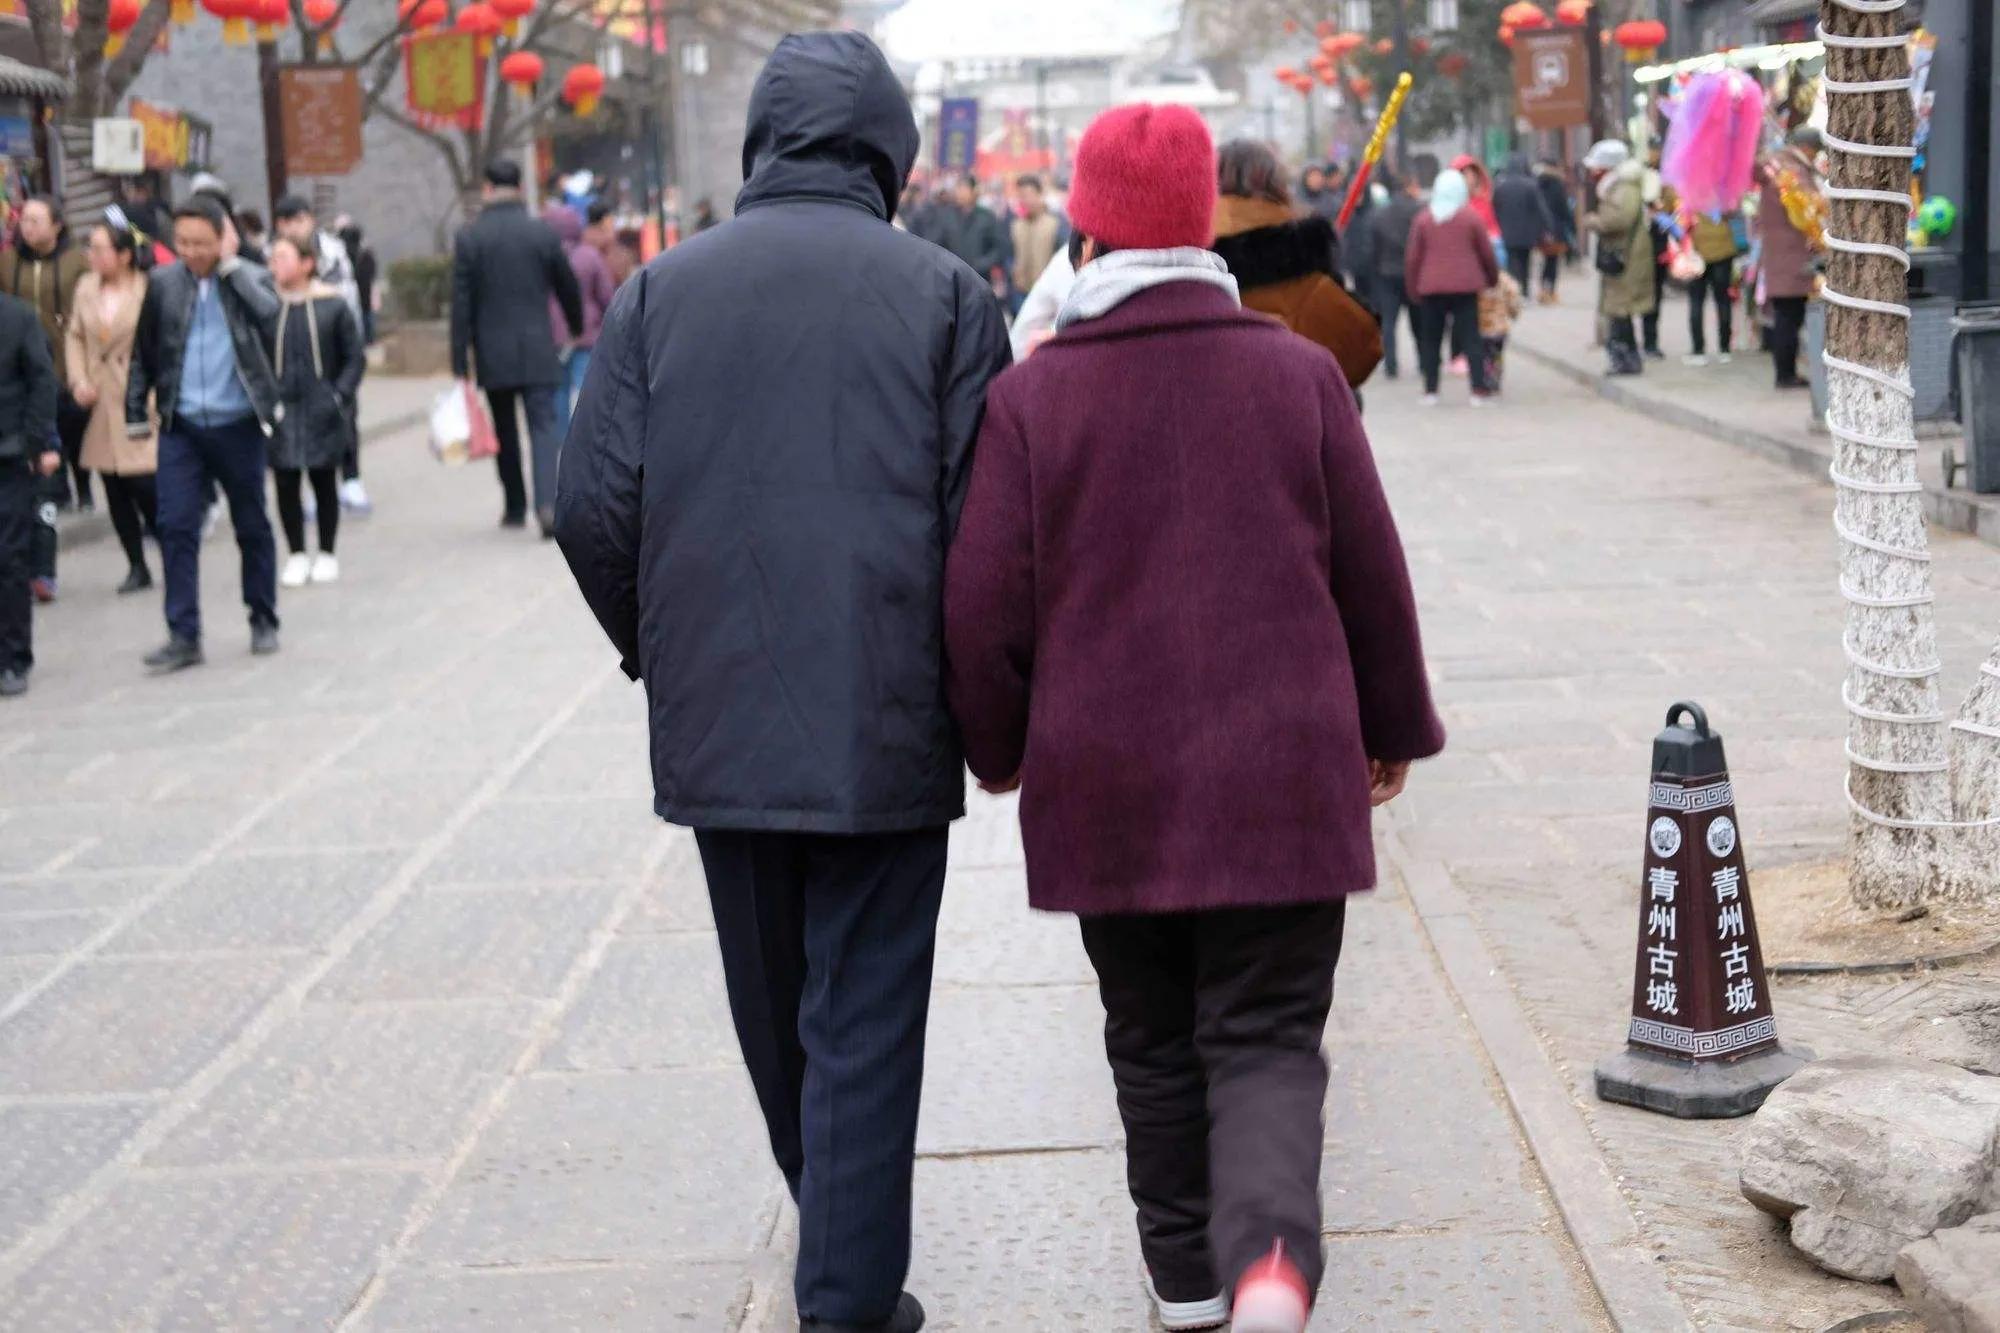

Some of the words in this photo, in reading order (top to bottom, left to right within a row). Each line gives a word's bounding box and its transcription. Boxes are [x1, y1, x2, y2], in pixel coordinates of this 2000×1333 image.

[1647, 867, 1679, 1015] 青州古城
[1711, 866, 1757, 1014] 青州古城
